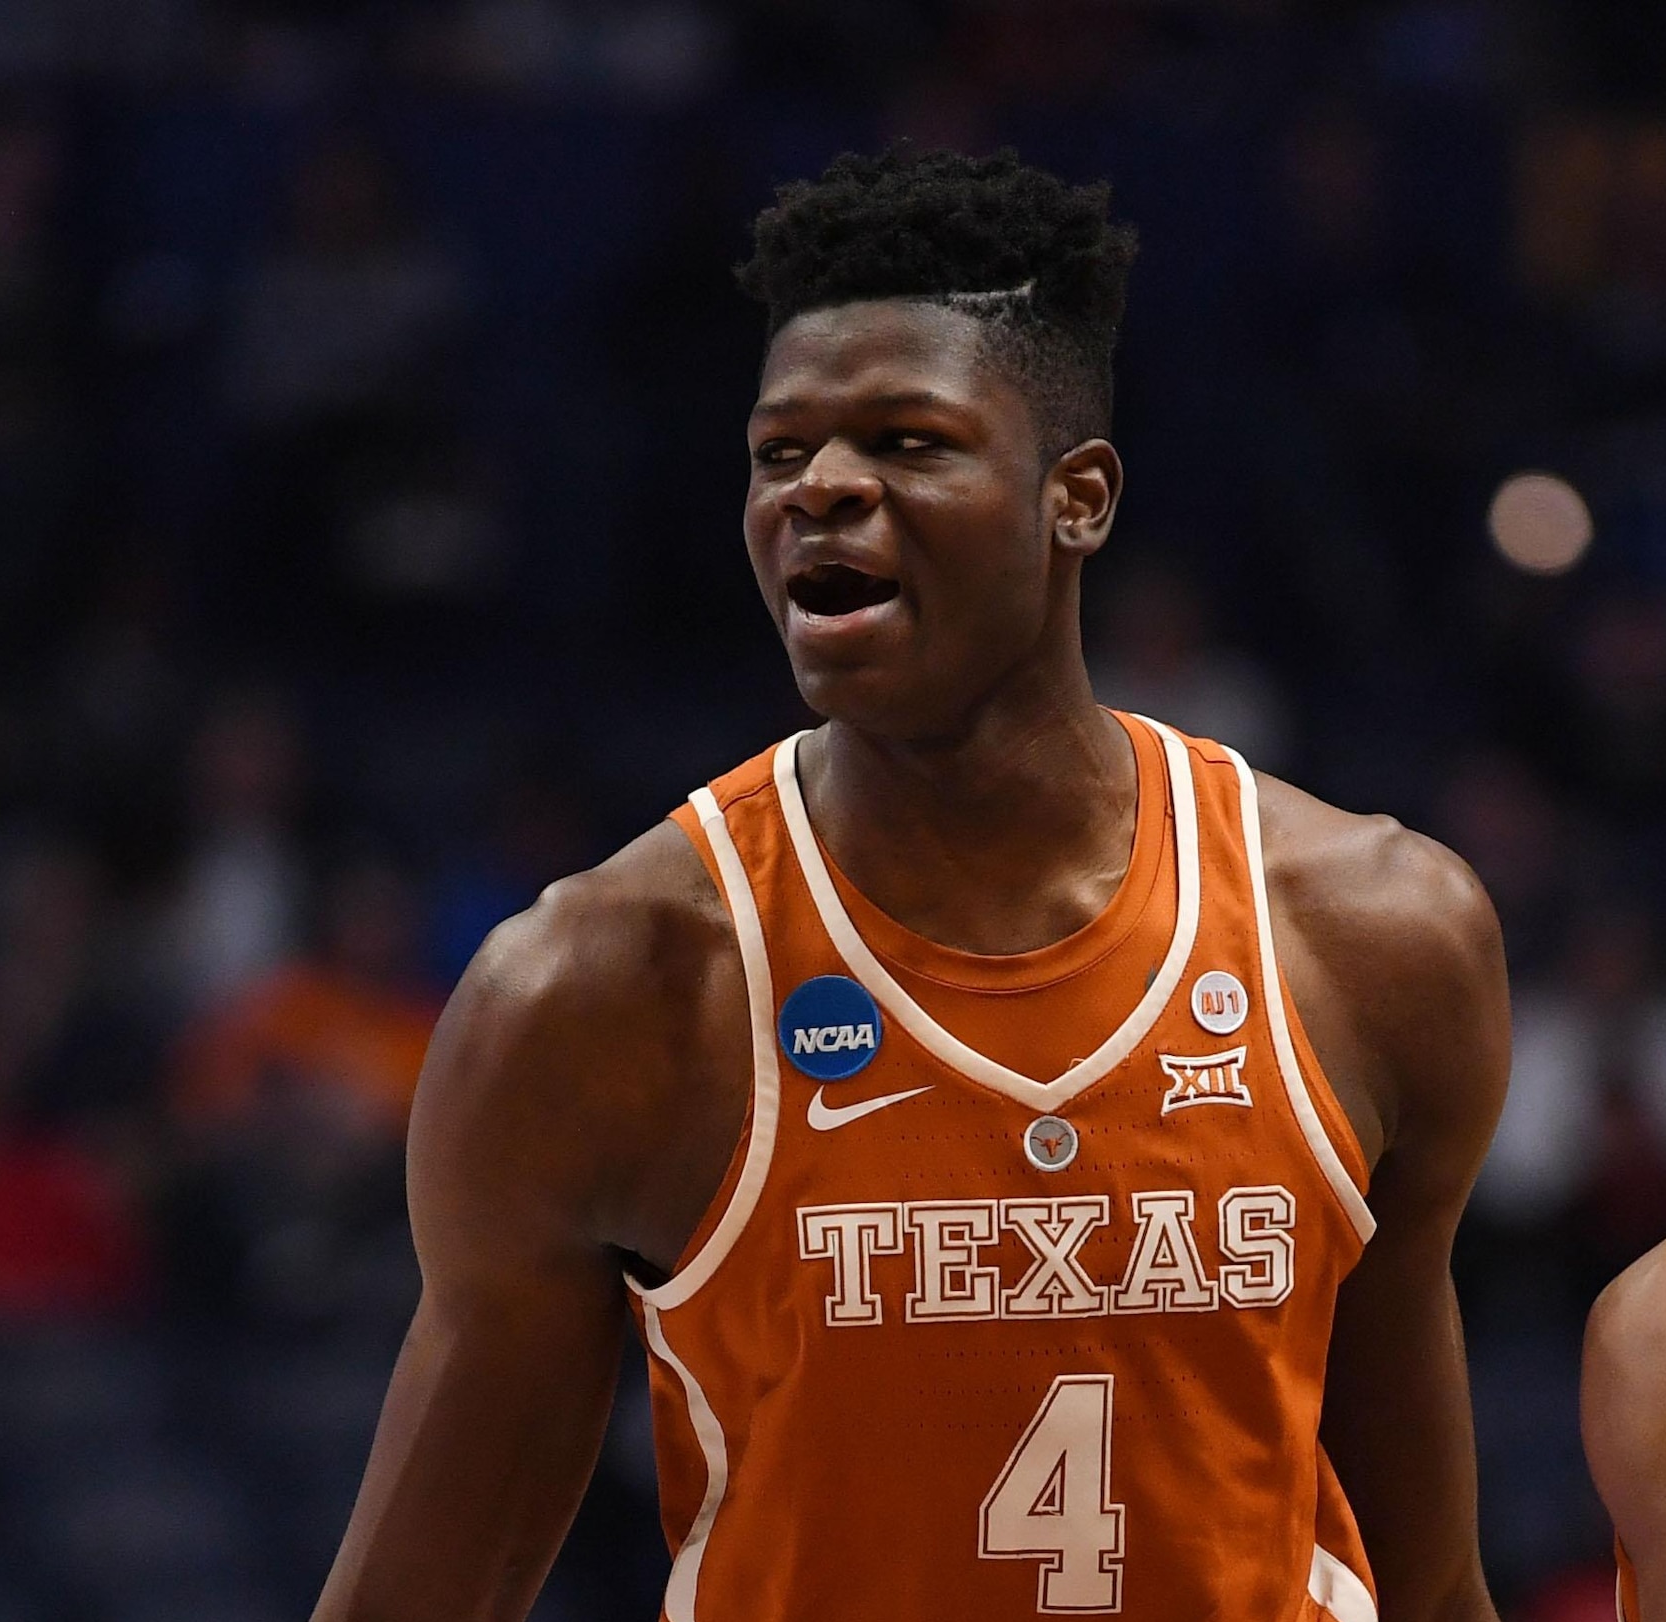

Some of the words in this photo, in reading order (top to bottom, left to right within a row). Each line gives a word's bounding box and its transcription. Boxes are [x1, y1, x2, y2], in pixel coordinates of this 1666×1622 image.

[793, 1023, 876, 1054] NCAA
[1163, 1052, 1249, 1110] XII
[796, 1185, 1296, 1327] TEXAS
[978, 1374, 1125, 1614] 4
